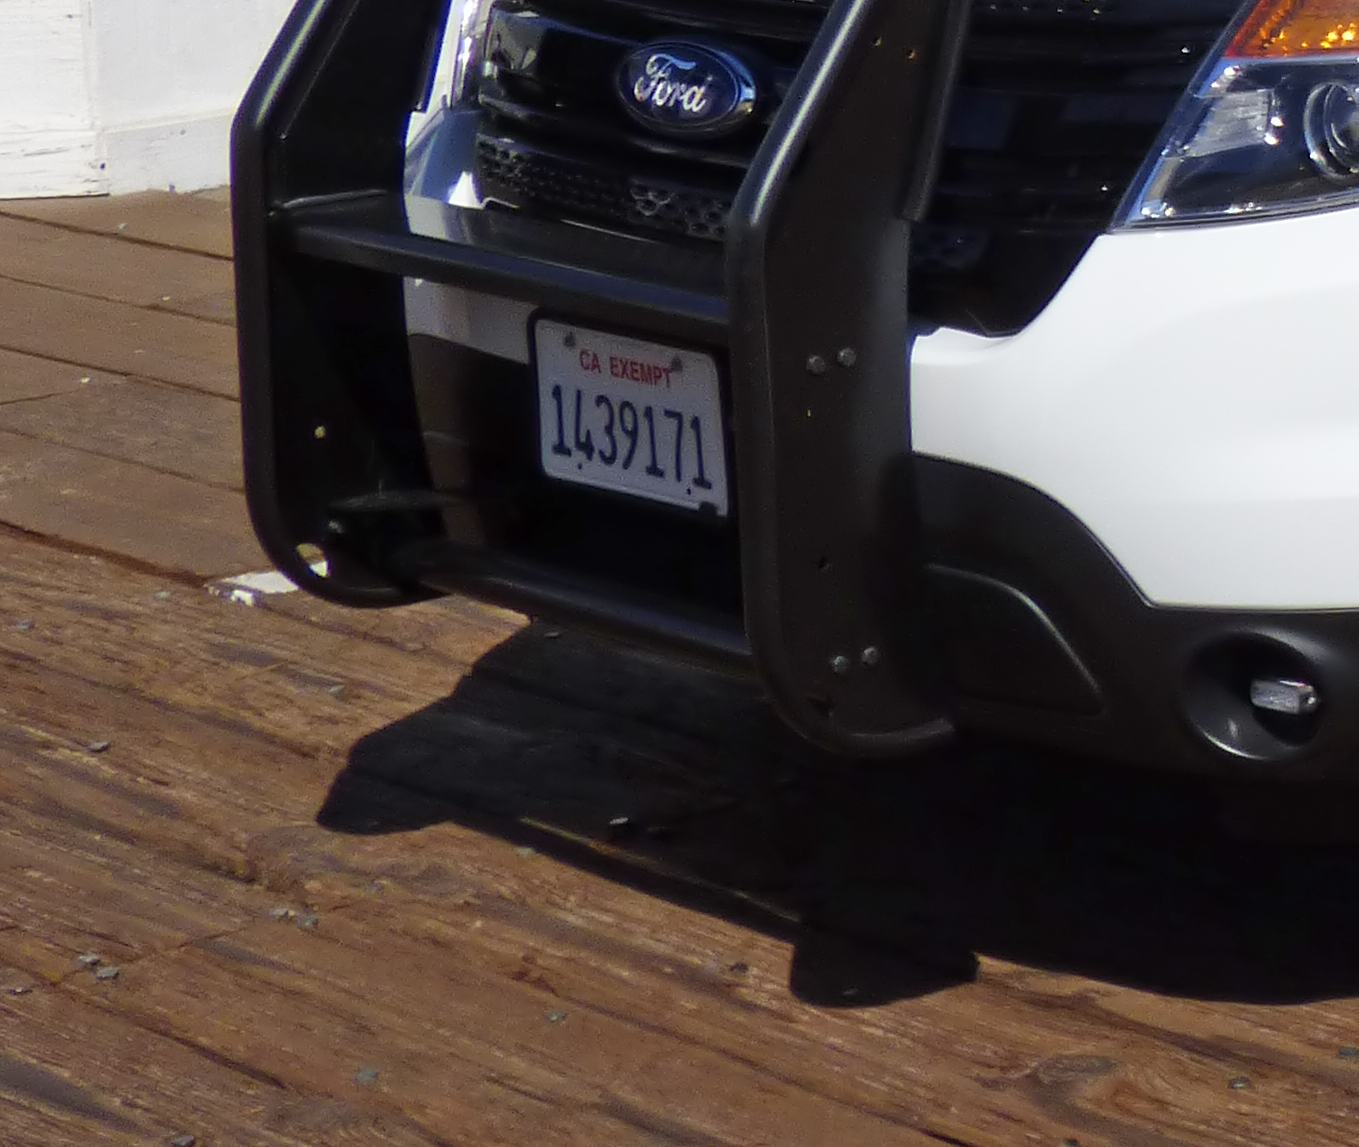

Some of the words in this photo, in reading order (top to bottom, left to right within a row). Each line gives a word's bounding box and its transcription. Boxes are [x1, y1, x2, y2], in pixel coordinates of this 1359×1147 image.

[633, 53, 714, 114] Ford
[579, 350, 601, 374] CA
[609, 355, 674, 388] EXEMPT
[552, 384, 712, 490] 1439171
